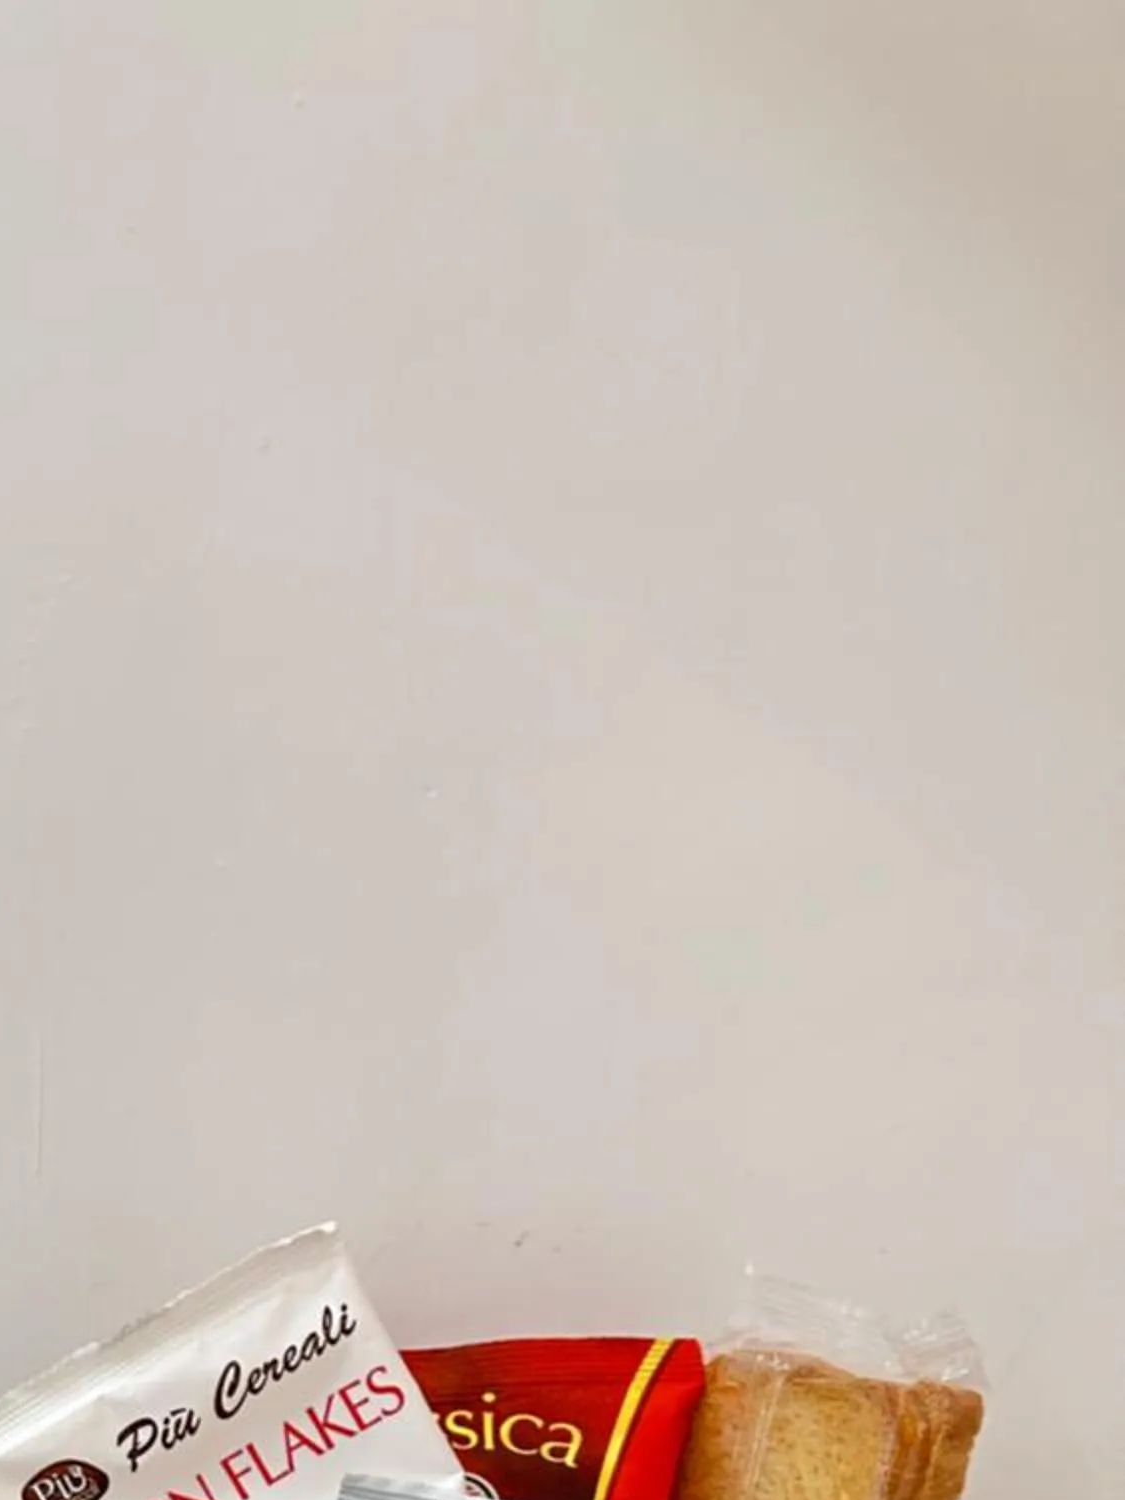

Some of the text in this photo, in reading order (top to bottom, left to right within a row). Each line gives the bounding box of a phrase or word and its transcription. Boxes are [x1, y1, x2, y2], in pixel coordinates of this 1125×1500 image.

[214, 1302, 357, 1420] Cereali
[219, 1364, 406, 1500] FLAKES
[433, 1390, 583, 1469] sica
